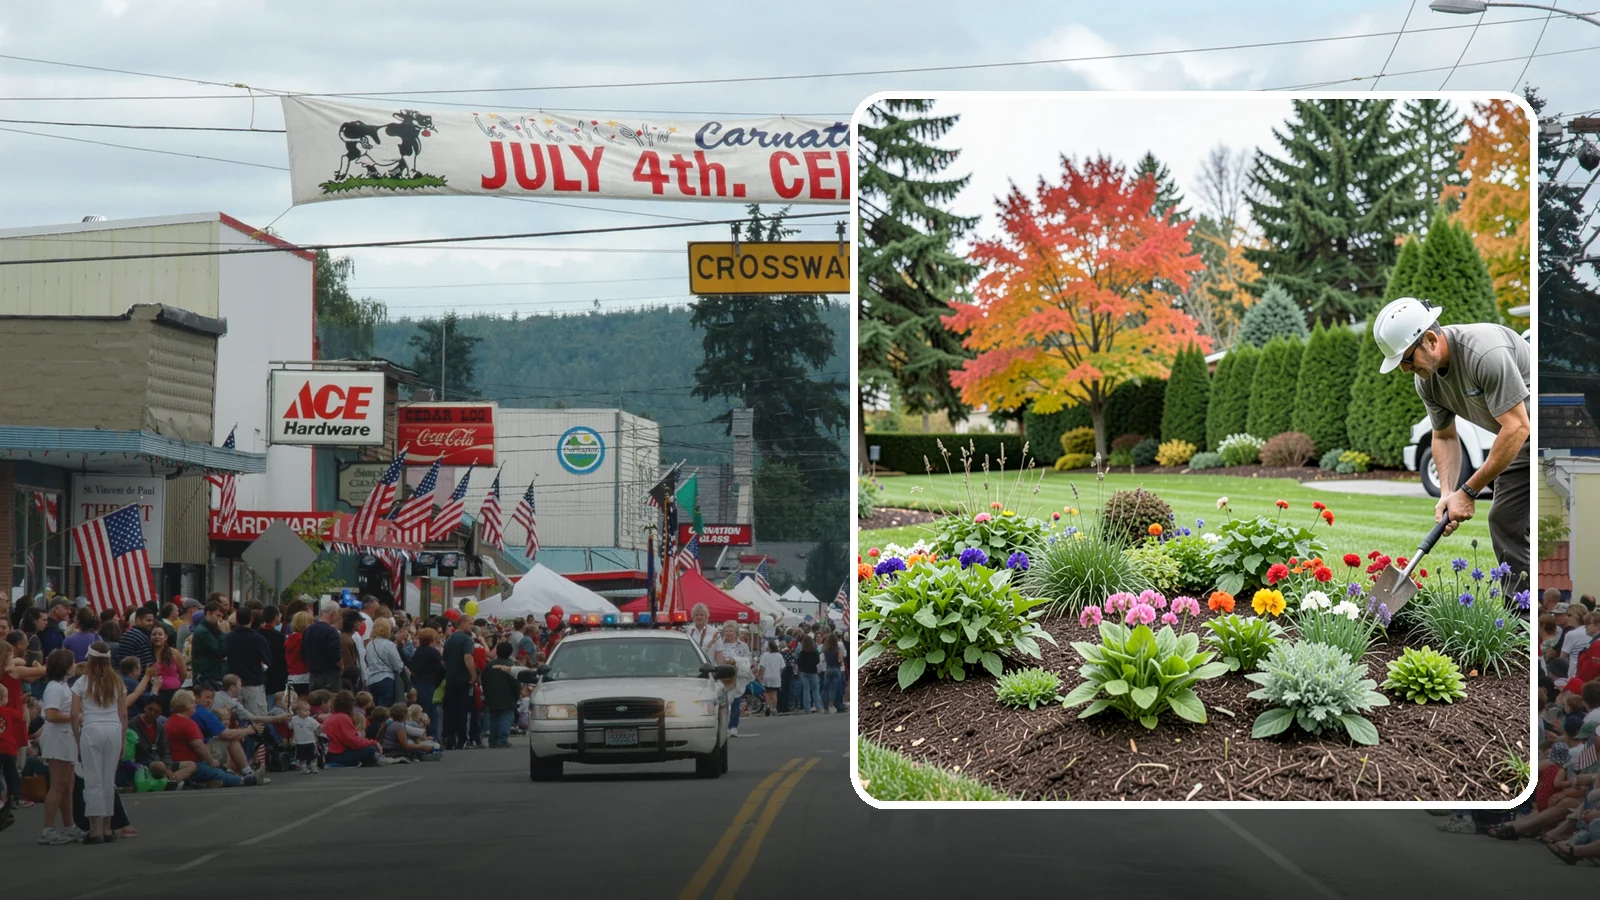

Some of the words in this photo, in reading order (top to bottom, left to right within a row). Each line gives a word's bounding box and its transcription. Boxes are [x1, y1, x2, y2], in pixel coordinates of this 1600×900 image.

[695, 121, 850, 150] Carnat
[481, 140, 605, 193] JULY
[632, 149, 746, 198] 4th.
[696, 254, 850, 280] CROSSWA
[283, 380, 373, 420] ACE
[406, 409, 452, 422] CEDAR
[284, 421, 371, 437] Hardware
[416, 428, 477, 447] Coca-Cola
[353, 467, 384, 480] Simpl
[83, 485, 93, 494] St.
[95, 485, 124, 495] Vincent
[126, 486, 135, 495] de
[138, 486, 155, 495] Paul
[81, 503, 154, 522] THRT
[688, 526, 742, 535] CRNATION
[699, 535, 730, 543] GLASS
